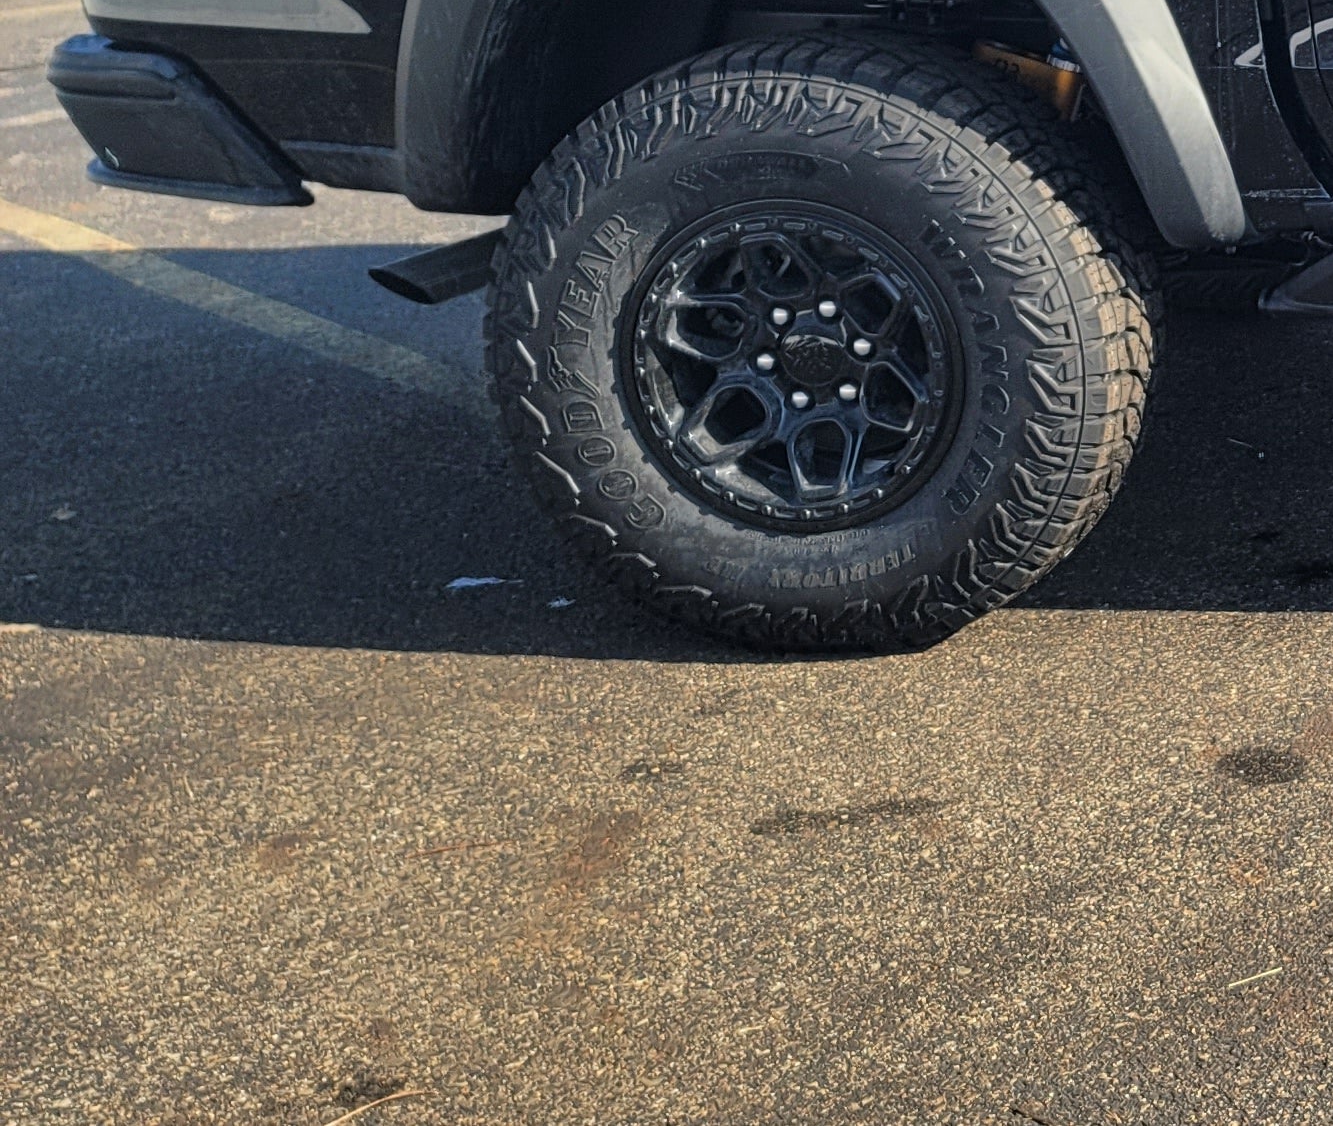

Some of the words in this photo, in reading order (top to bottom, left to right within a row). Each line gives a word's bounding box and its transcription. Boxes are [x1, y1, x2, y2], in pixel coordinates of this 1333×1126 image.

[548, 214, 667, 530] GOODYEAR
[917, 216, 1011, 516] WRANGLER
[769, 543, 917, 590] TERRITORY
